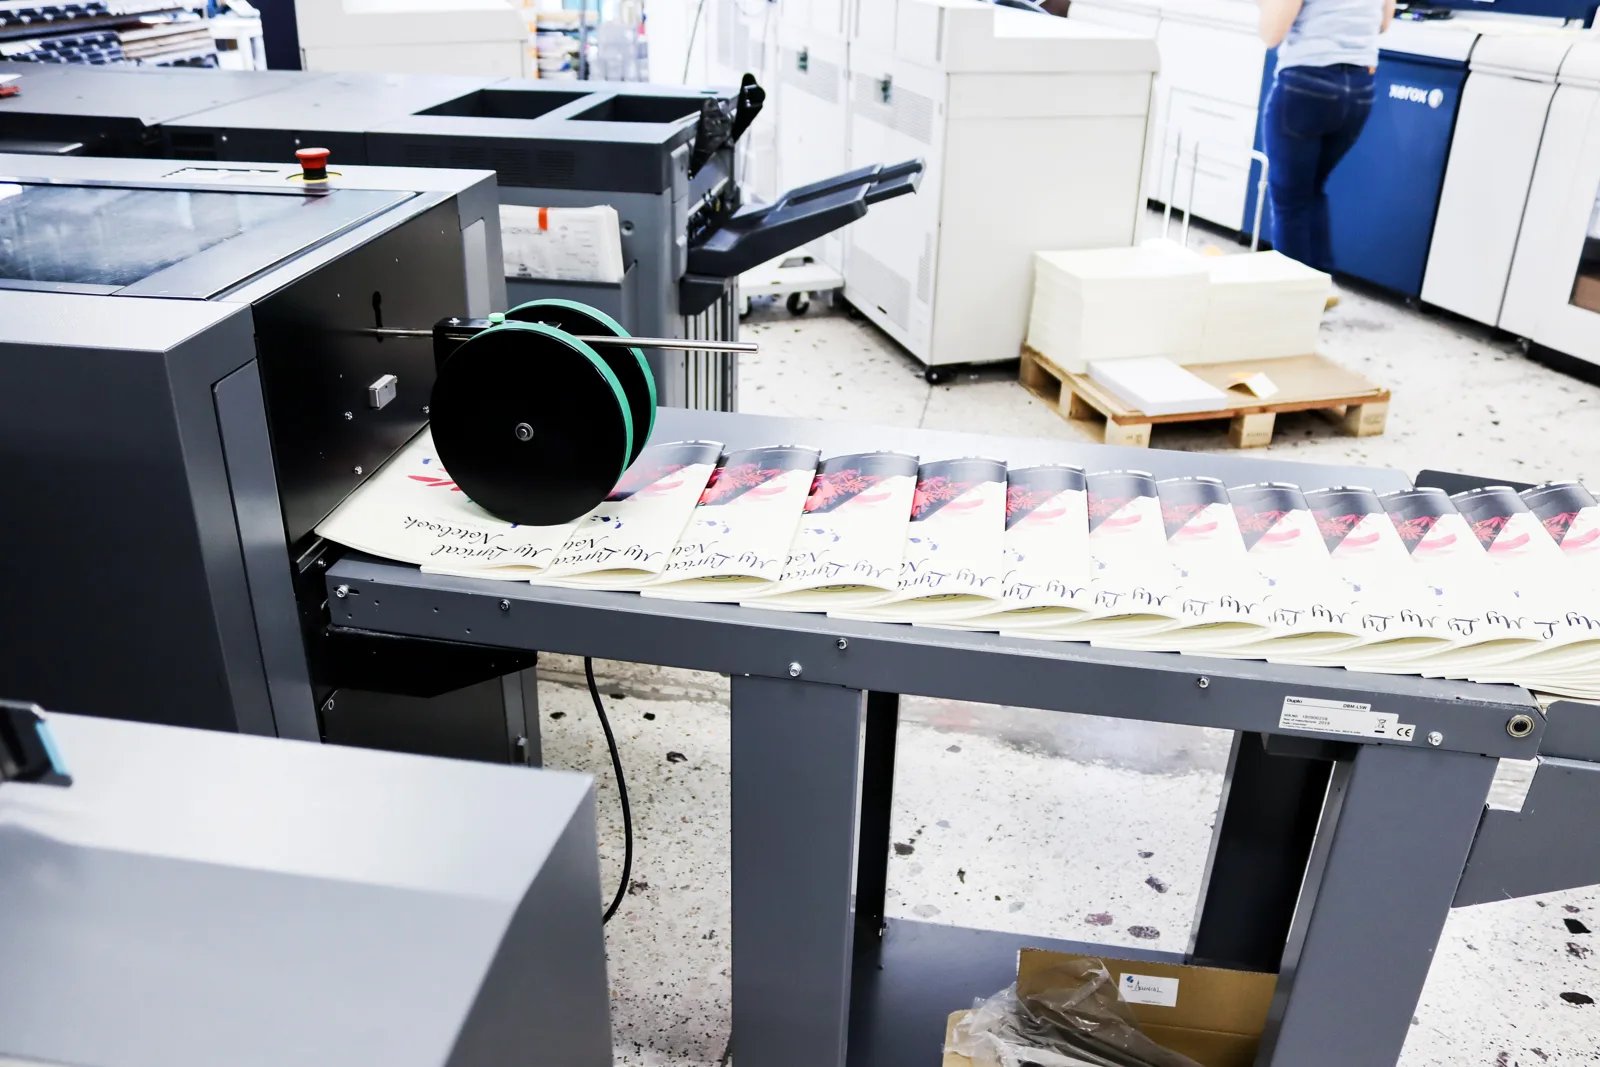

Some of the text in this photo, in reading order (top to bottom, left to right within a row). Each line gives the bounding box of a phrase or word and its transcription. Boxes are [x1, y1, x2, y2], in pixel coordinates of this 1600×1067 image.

[1389, 84, 1428, 104] xerox
[403, 515, 503, 546] Notebook
[430, 543, 552, 561] My Lyrical
[624, 544, 663, 563] My
[738, 550, 778, 569] My
[853, 559, 894, 578] My
[956, 568, 997, 587] My
[1046, 579, 1087, 599] My
[1132, 586, 1172, 606] My
[1220, 594, 1259, 614] My
[1312, 603, 1351, 624] My
[1400, 608, 1441, 628] My
[1486, 610, 1528, 629] My
[1565, 611, 1600, 630] My
